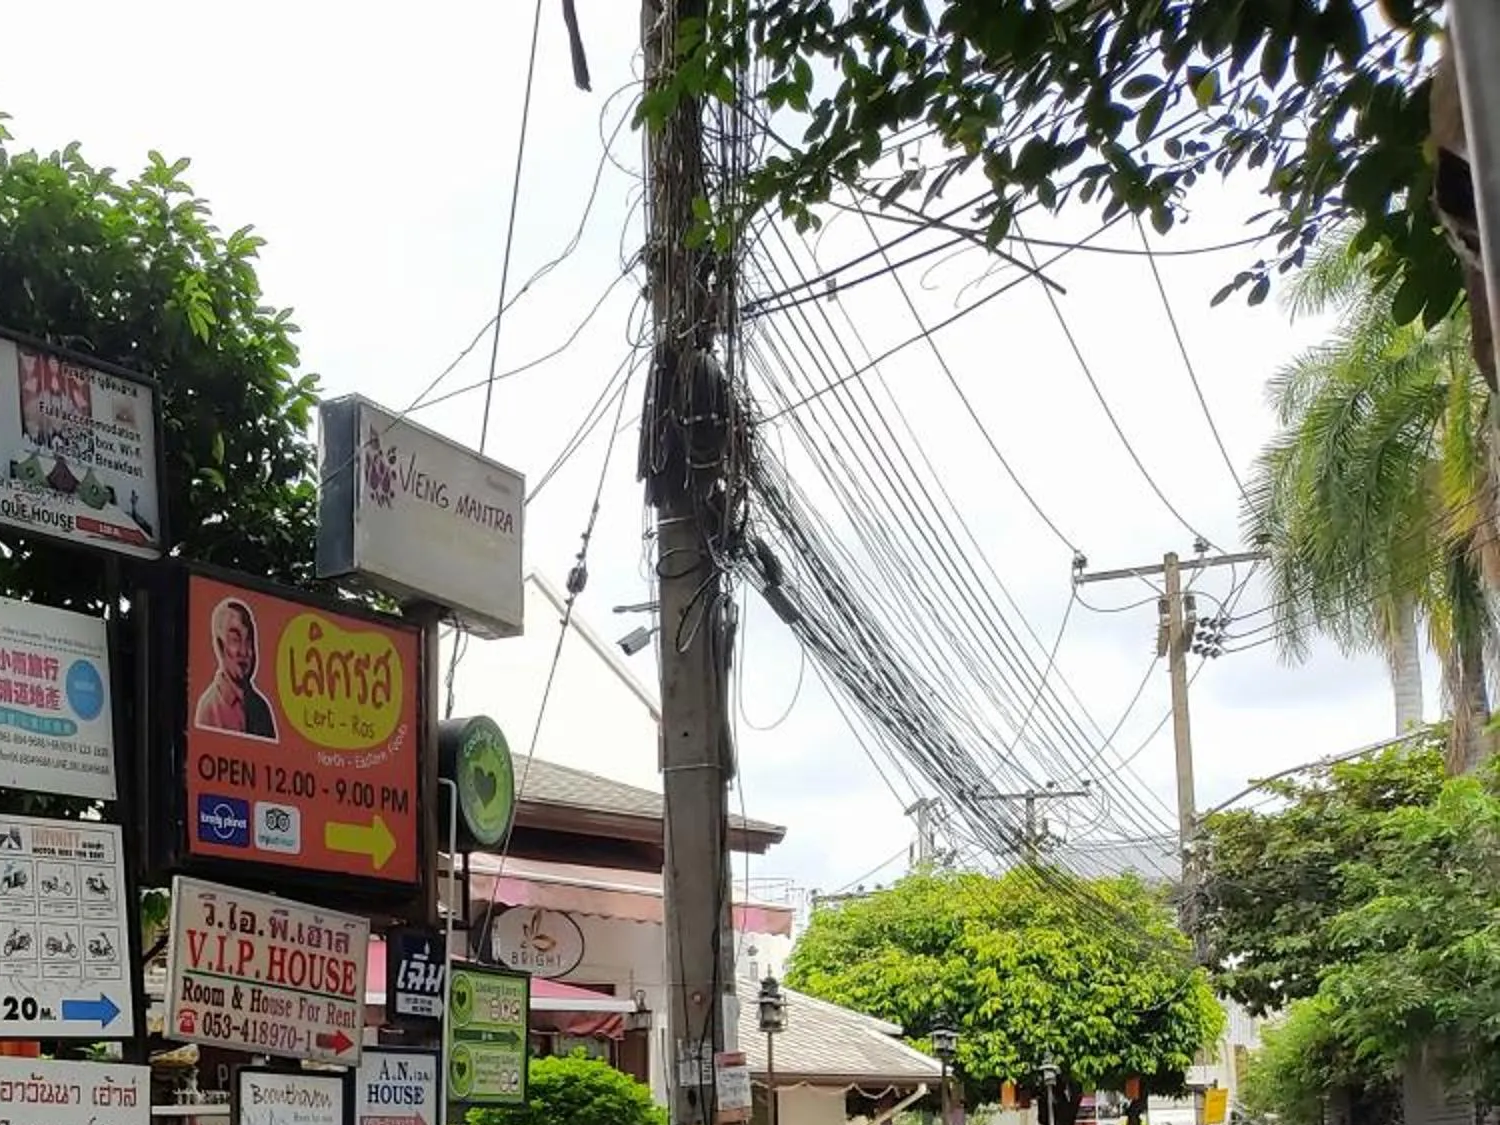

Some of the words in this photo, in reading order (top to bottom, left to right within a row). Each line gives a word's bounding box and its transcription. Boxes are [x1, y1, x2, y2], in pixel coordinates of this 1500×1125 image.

[400, 453, 449, 508] VIENG
[456, 496, 514, 533] MANTRA
[32, 505, 75, 529] HOUSE
[304, 707, 334, 729] Lert
[352, 717, 375, 739] Ros
[198, 754, 256, 787] OPEN
[265, 765, 315, 798] 12.00
[336, 779, 375, 809] 9.00
[381, 788, 409, 815] PM
[266, 945, 357, 997] HOUSE
[2, 995, 38, 1022] 20
[182, 976, 225, 1007] Room
[231, 984, 243, 1009] &
[251, 989, 292, 1018] House
[299, 999, 321, 1023] For
[326, 1002, 356, 1029] Rent
[202, 1011, 311, 1052] 053-418970-1
[366, 1083, 425, 1106] HOUSE
